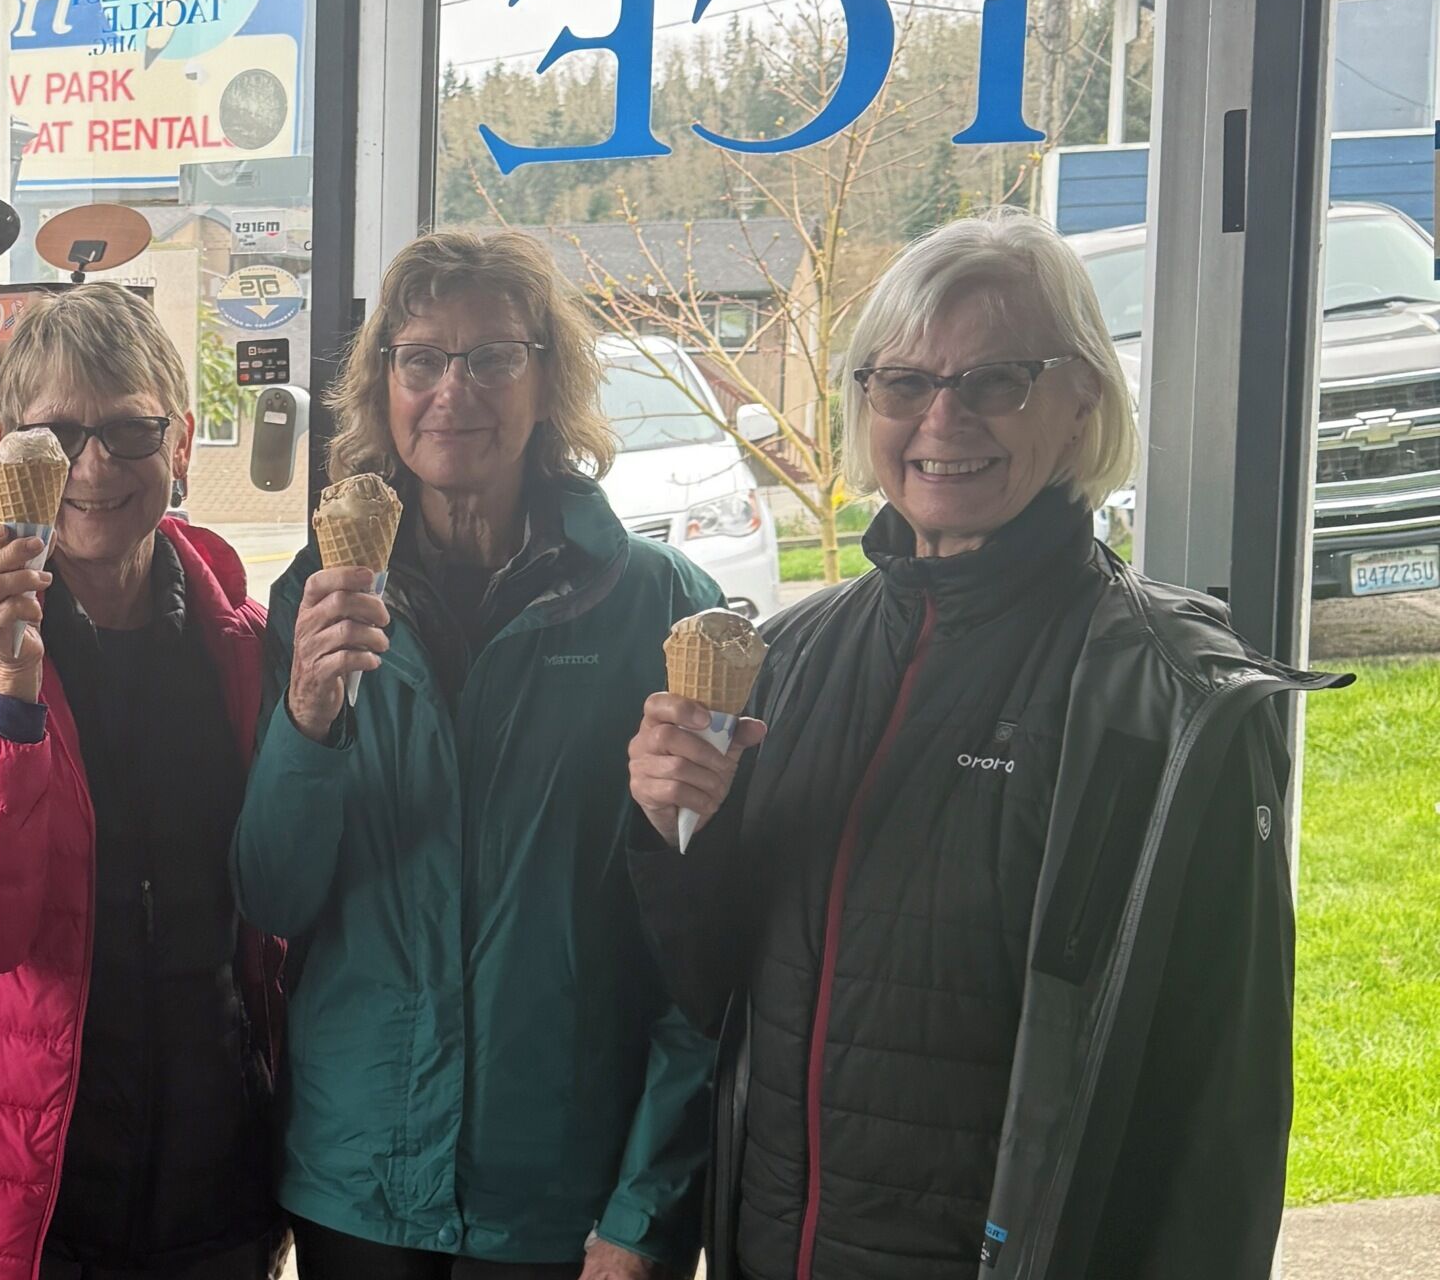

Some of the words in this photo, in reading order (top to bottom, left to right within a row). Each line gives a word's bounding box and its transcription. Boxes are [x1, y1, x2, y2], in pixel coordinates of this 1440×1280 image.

[45, 69, 136, 105] PARK
[20, 120, 73, 155] AT
[88, 115, 235, 152] RENTAL
[1357, 561, 1434, 588] B47225U
[542, 653, 599, 666] Marmot
